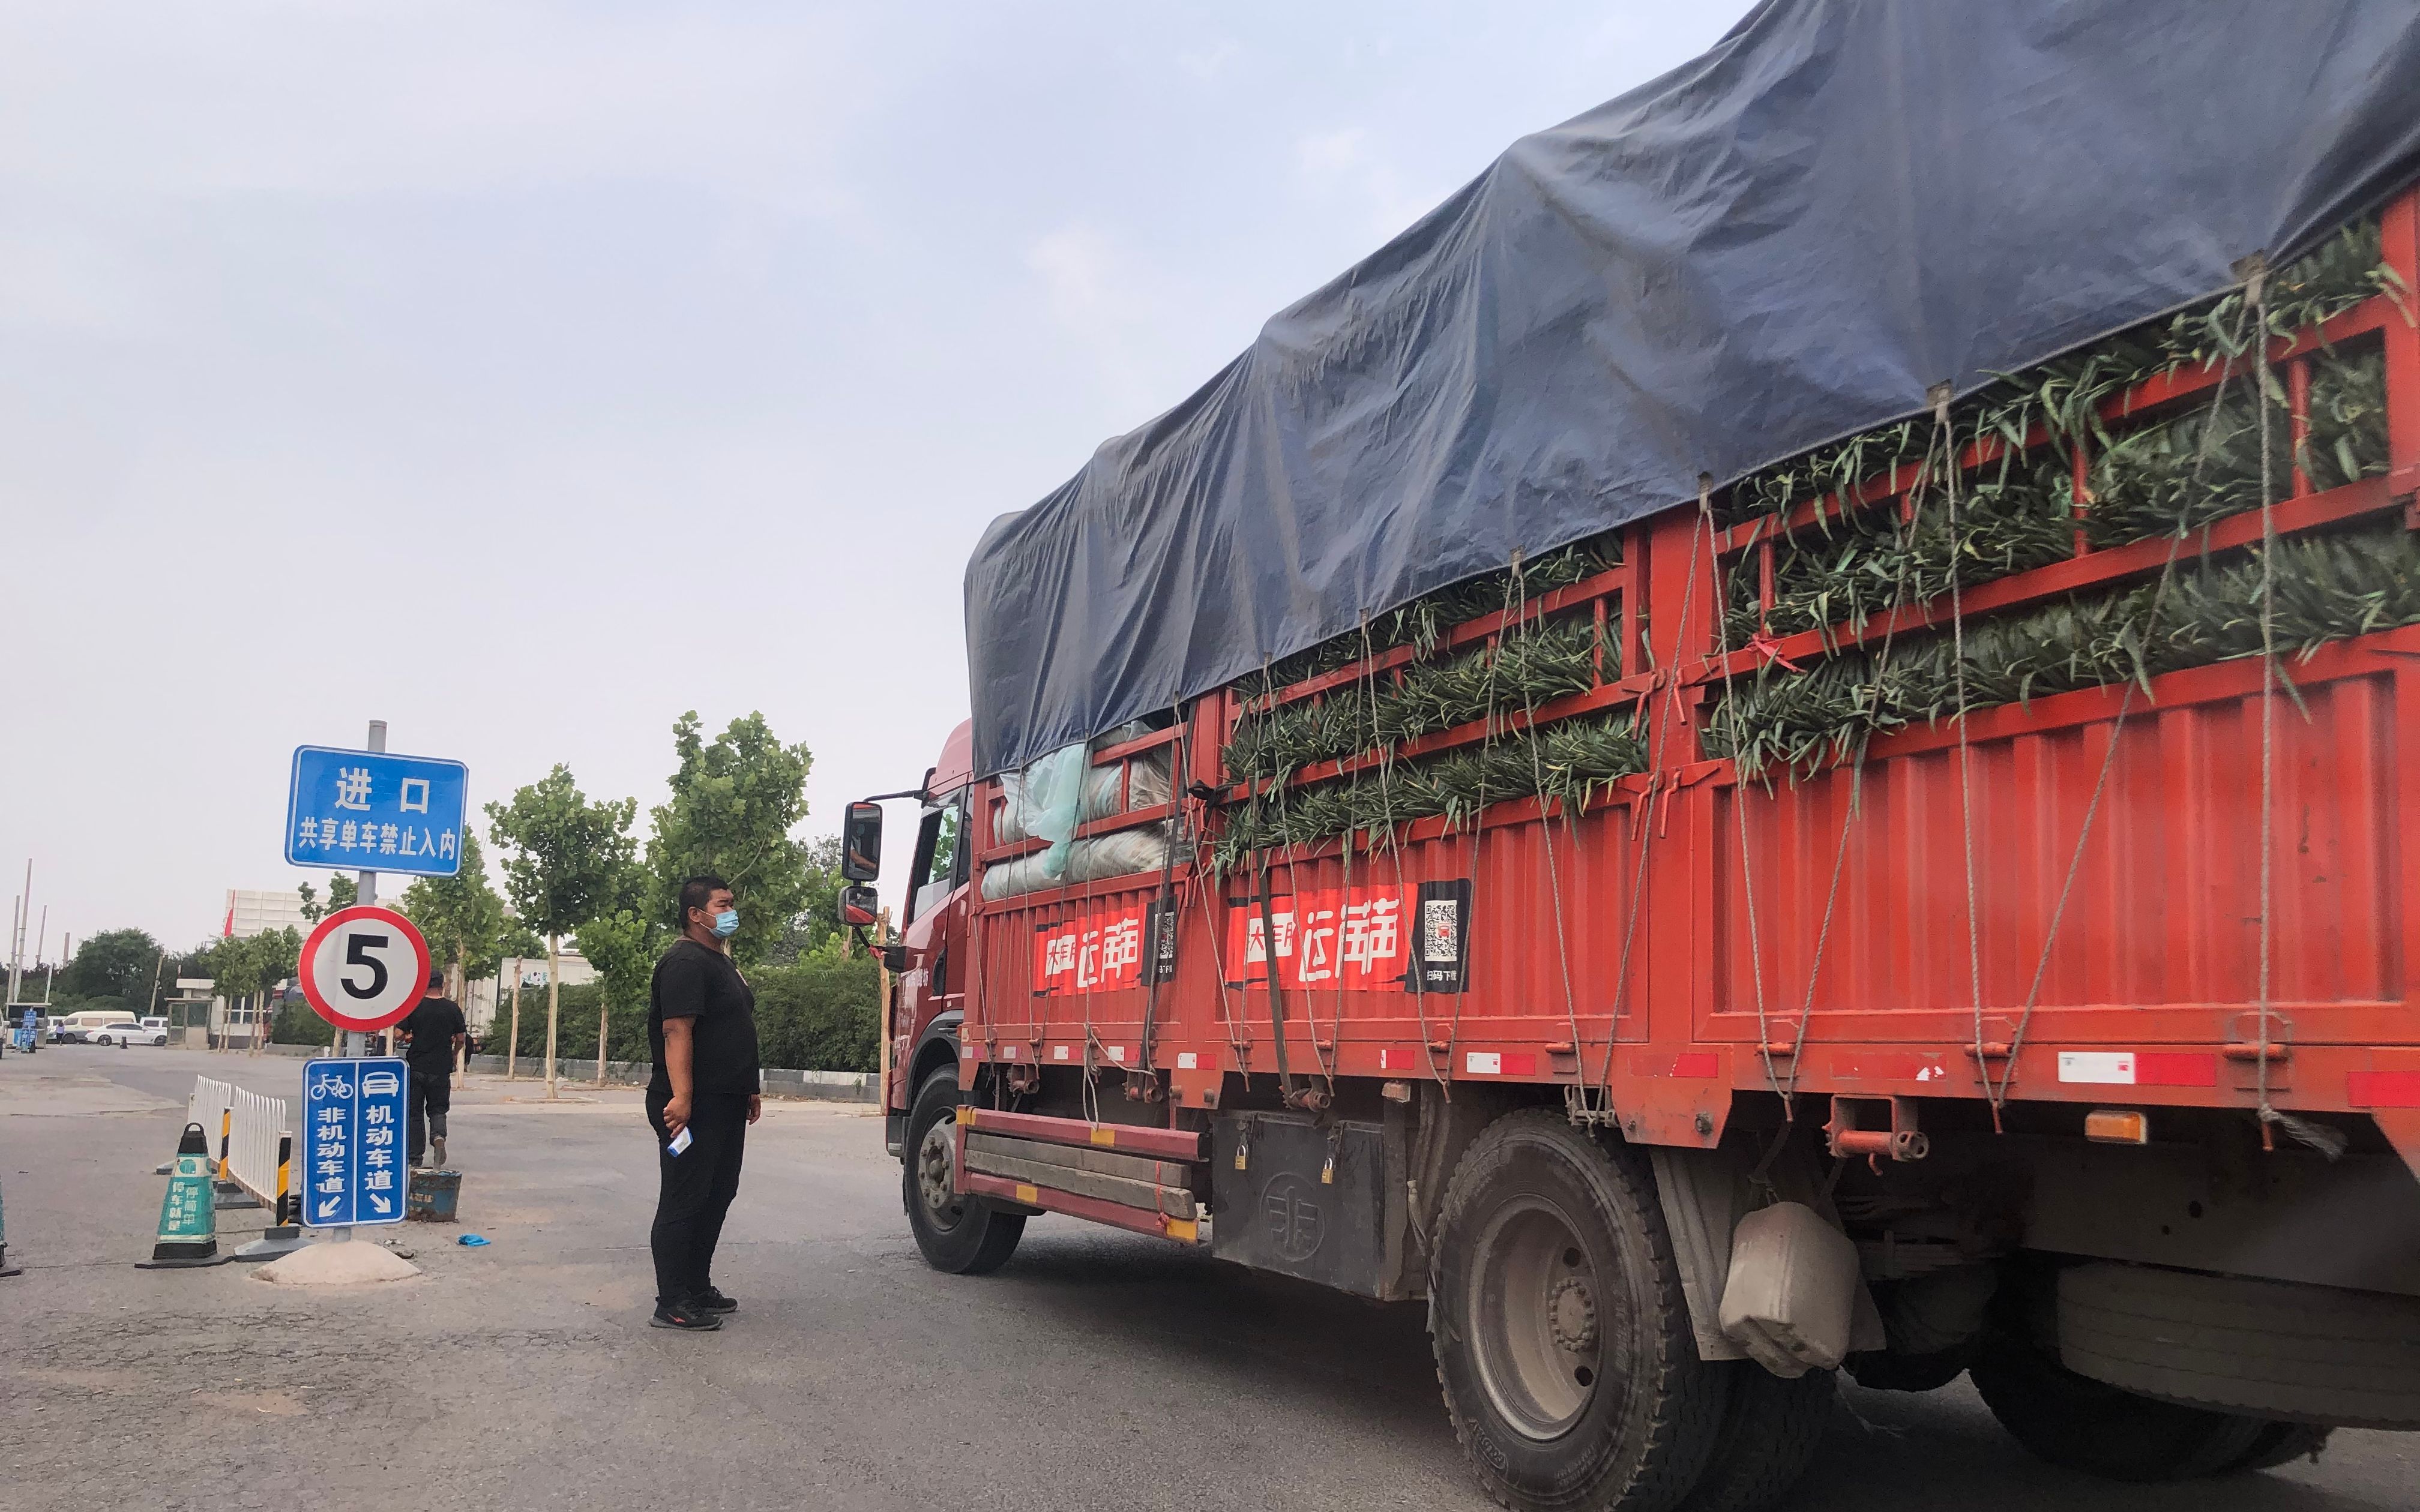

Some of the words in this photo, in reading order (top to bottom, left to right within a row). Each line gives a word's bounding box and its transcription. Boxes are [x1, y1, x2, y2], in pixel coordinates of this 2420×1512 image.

[335, 767, 430, 814] 进口
[299, 817, 456, 860] 共享单车禁止入内
[340, 934, 389, 1000] 5
[316, 1107, 347, 1193] 非机动车道
[364, 1105, 394, 1190] 机动车道
